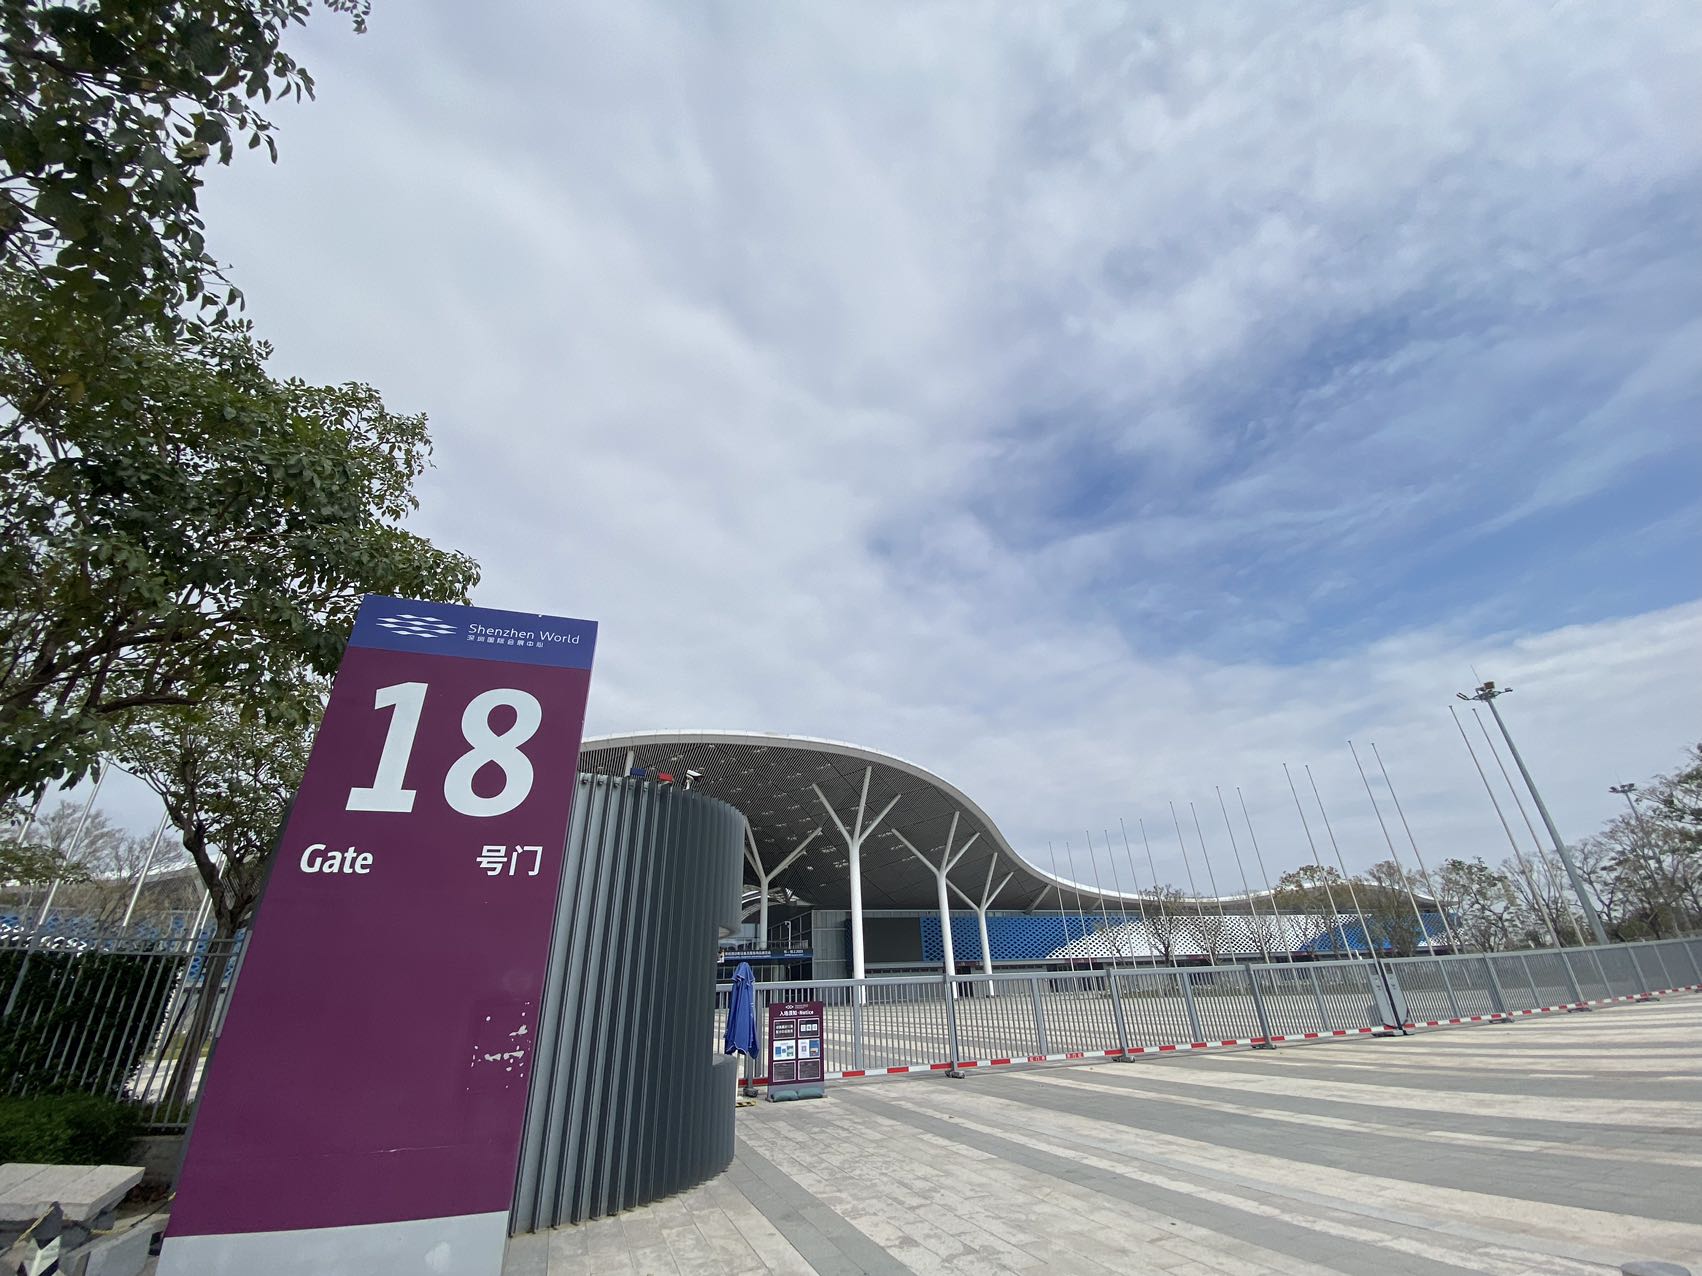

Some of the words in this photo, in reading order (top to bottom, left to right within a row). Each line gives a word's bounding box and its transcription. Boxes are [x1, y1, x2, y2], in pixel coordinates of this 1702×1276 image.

[468, 623, 535, 640] Shenzhen
[540, 631, 580, 645] World
[345, 682, 542, 817] 18
[300, 844, 374, 874] Gate
[476, 845, 543, 876] 号门
